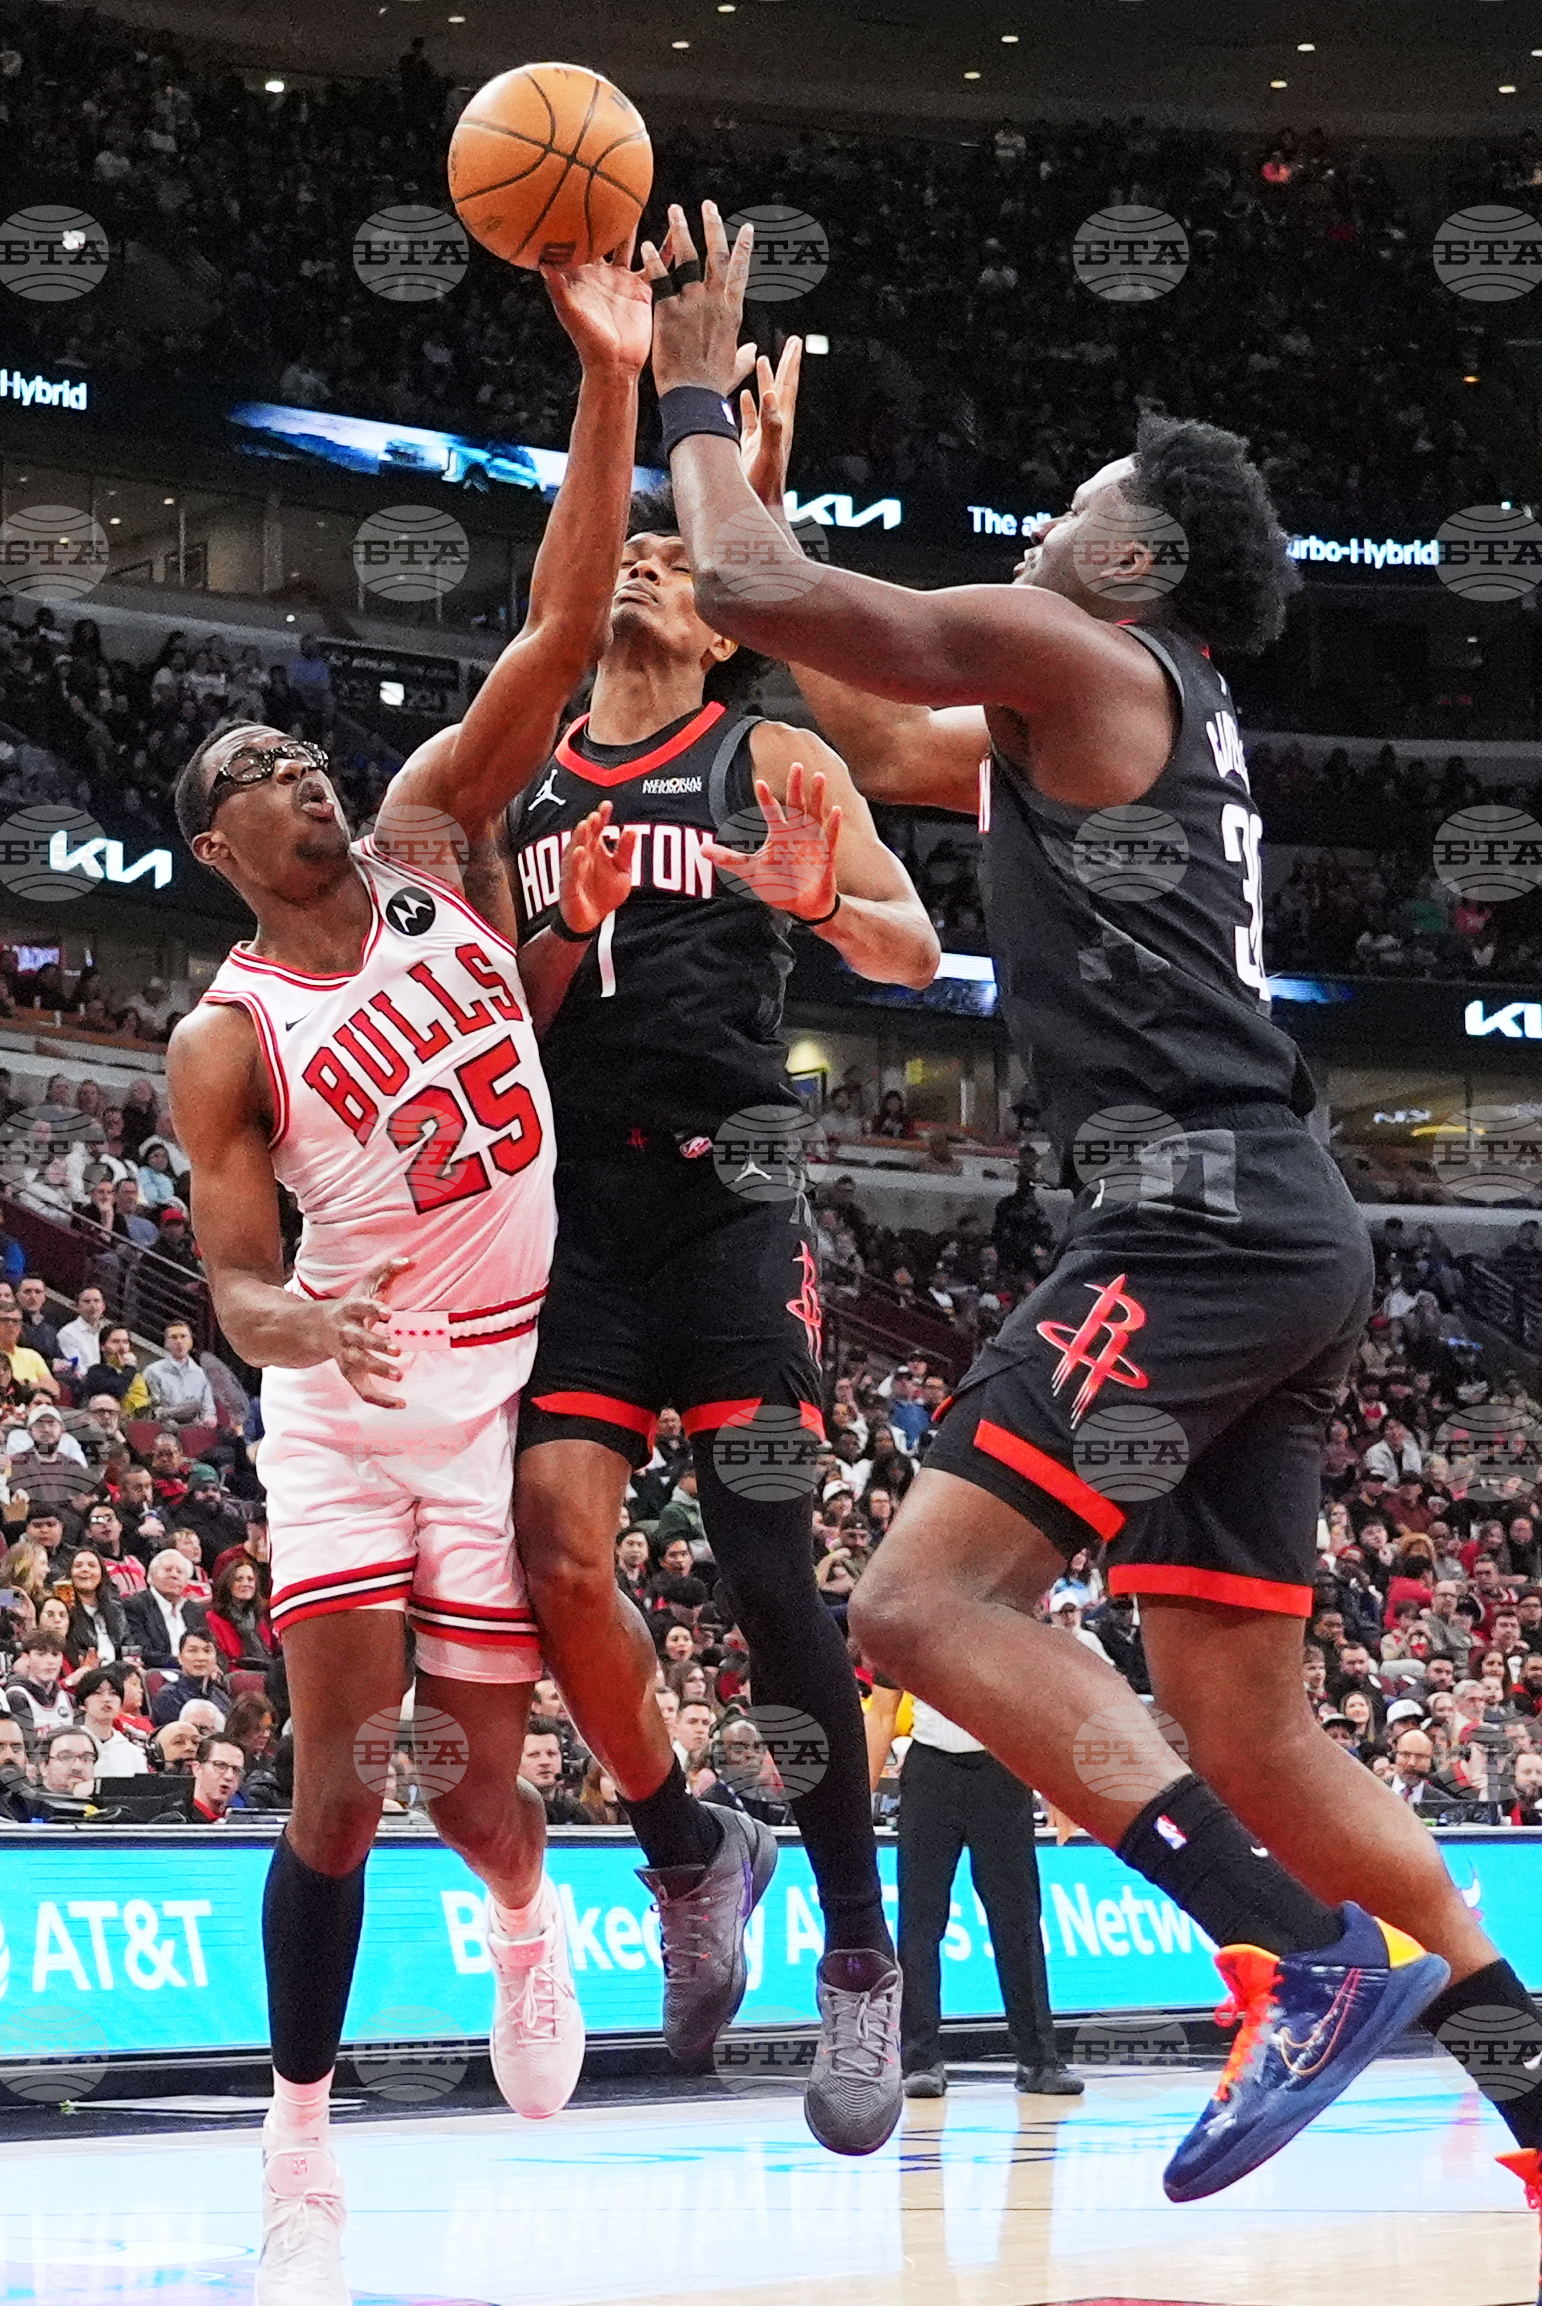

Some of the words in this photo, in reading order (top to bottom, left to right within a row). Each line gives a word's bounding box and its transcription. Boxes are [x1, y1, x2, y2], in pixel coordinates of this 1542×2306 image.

[0, 368, 87, 410] Hybrid
[967, 506, 1017, 536] The
[1285, 535, 1439, 569] urbo-Hybrid
[517, 823, 716, 919] HOTON
[302, 943, 524, 1148] BULLS
[1465, 1000, 1542, 1039] KI
[386, 1034, 543, 1215] 25
[32, 1898, 212, 1992] AT&T
[440, 1883, 664, 1974] Bke
[1051, 1882, 1221, 1956] Netw
